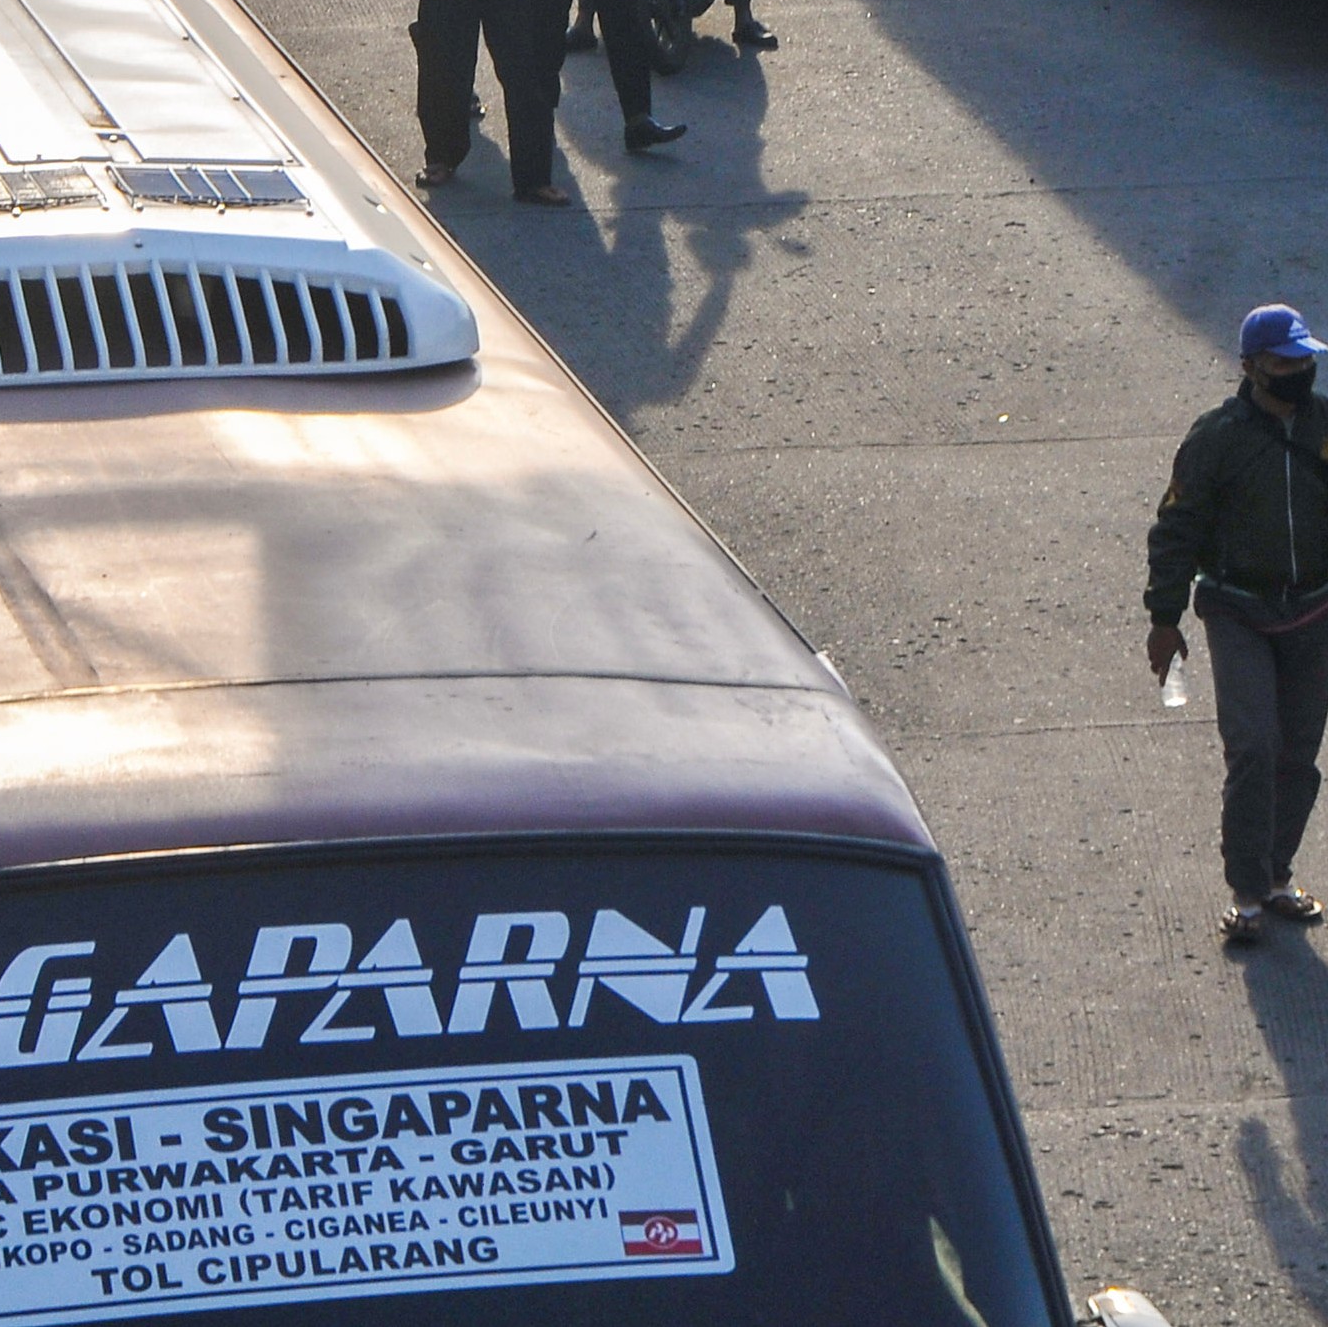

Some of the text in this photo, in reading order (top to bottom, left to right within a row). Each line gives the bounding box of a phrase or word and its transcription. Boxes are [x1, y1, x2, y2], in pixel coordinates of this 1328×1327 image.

[159, 1133, 182, 1147] -
[201, 1078, 672, 1153] SINGAPARNA
[22, 1193, 224, 1236] EKONOMI
[239, 1180, 374, 1218] (TARIF
[389, 1162, 616, 1205] KAWASAN)
[32, 1145, 405, 1201] PURWAKARTA
[450, 1129, 629, 1166] GARUT
[122, 1223, 255, 1256] SADANG
[284, 1209, 430, 1241] CIGANEA
[457, 1197, 609, 1228] CILEUNYI
[90, 1235, 500, 1296] TOL CIPULARANG
